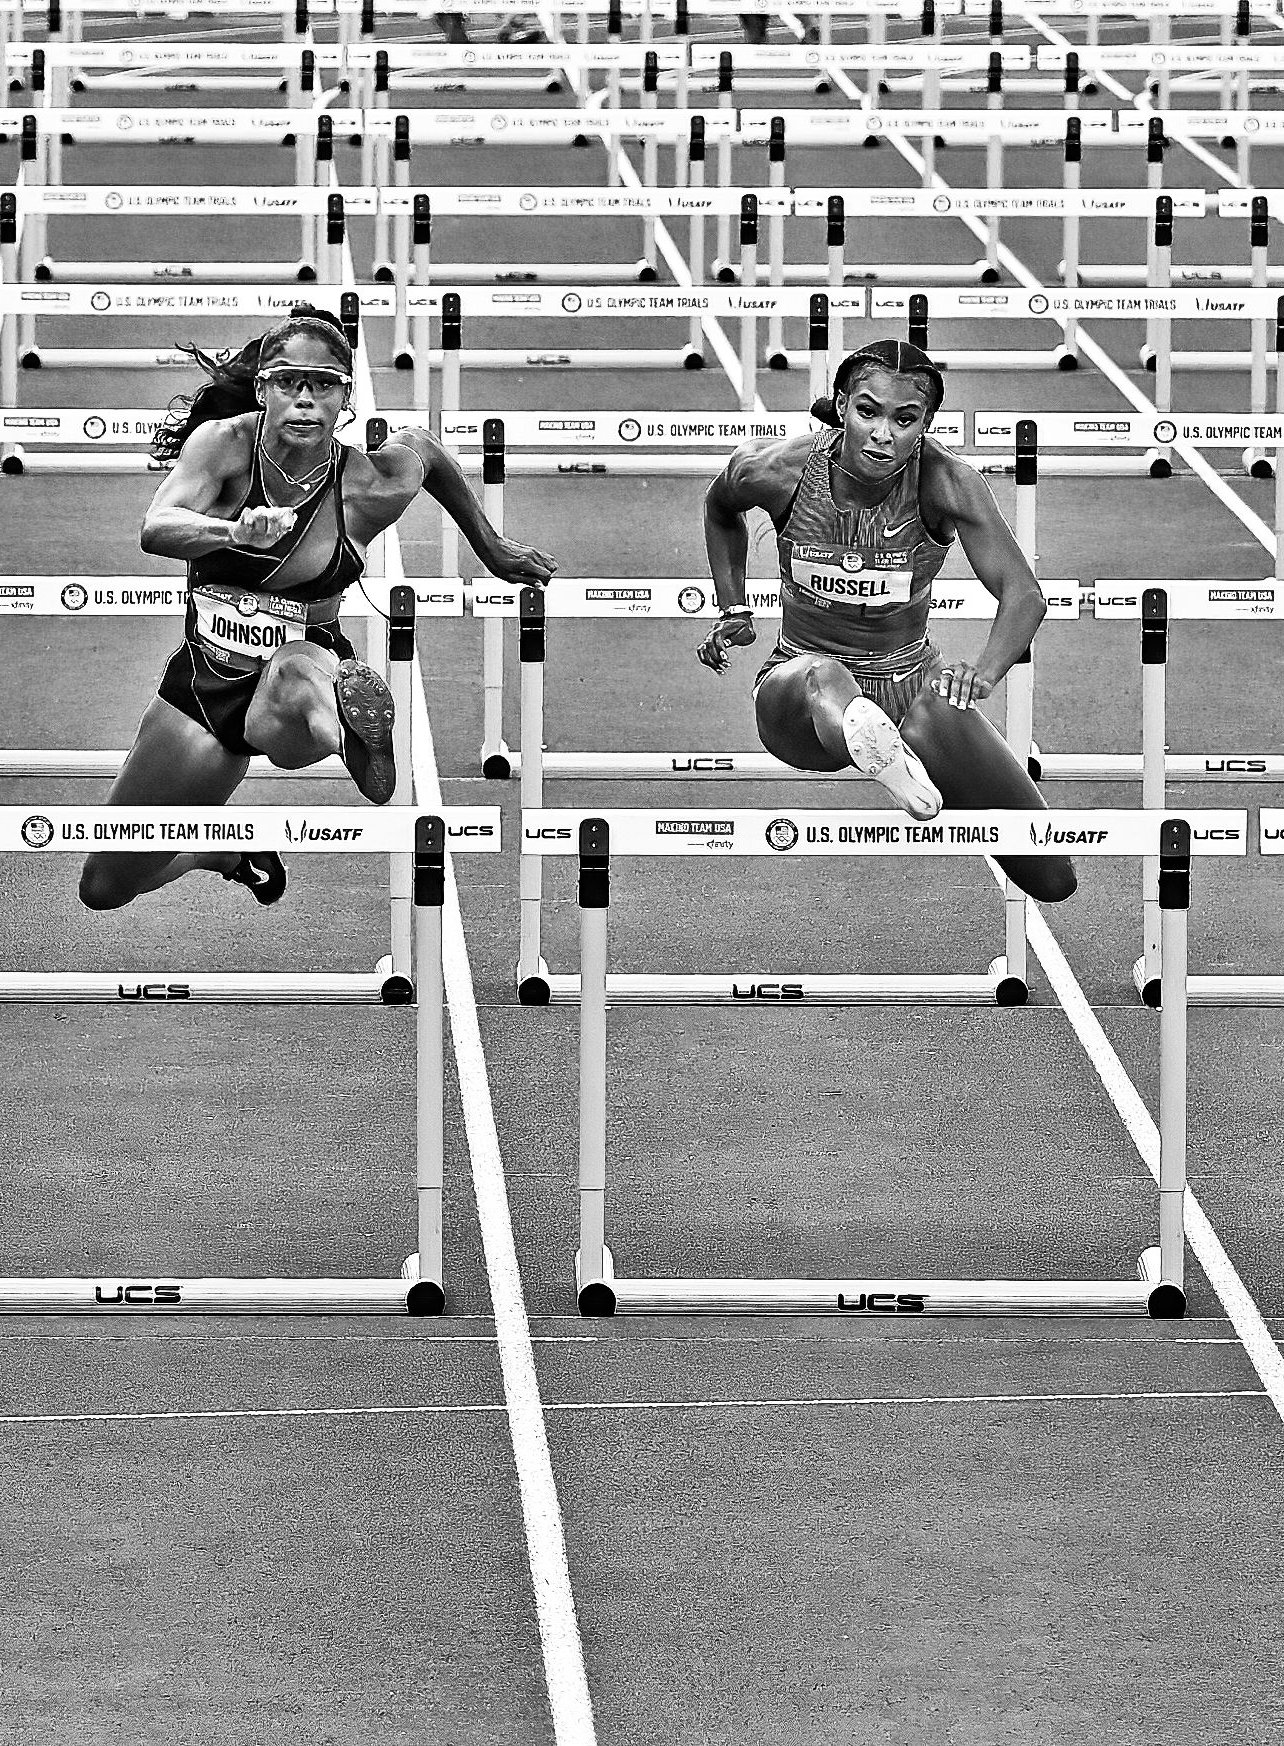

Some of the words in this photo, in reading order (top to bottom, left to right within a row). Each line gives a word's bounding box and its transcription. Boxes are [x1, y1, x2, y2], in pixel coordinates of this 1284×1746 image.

[608, 298, 645, 308] OLYMPIC
[649, 298, 673, 308] TEAM
[678, 298, 708, 308] TRIALS
[1075, 300, 1113, 309] OLYMPIC
[1117, 299, 1141, 309] TEAM
[1145, 299, 1176, 310] TRIALS
[113, 422, 128, 433] U.S.
[648, 424, 663, 436] U.S.
[671, 425, 714, 436] OLYMPIC
[719, 425, 745, 436] TEAM
[750, 425, 785, 436] TRIALS
[1183, 427, 1202, 438] U.S.
[1206, 427, 1250, 438] OLYMPIC
[1254, 427, 1281, 438] TEAM
[15, 587, 31, 597] USA
[810, 574, 891, 598] RUSSELL
[95, 591, 117, 604] U.S.
[122, 591, 172, 604] OLYMPIC
[476, 596, 515, 604] UCS
[632, 590, 648, 600] USA
[1099, 597, 1137, 605] UCS
[929, 598, 964, 609] SATF
[1044, 597, 1072, 608] CS
[210, 613, 287, 649] JOHNSON
[672, 758, 733, 770] UCS
[1205, 760, 1266, 772] UCS
[63, 824, 88, 839] U.S.
[94, 824, 154, 839] OLYMPIC
[160, 824, 198, 839] TEAM
[204, 824, 253, 840] TRIALS
[309, 828, 363, 840] USATF
[448, 826, 493, 836] UCS
[526, 829, 572, 839] UCS
[690, 822, 713, 833] TEAM
[714, 823, 732, 834] USA
[807, 827, 833, 843] U.S.
[839, 827, 899, 843] OLYMPIC
[905, 826, 943, 844] TEAM
[948, 827, 998, 843] TRIALS
[1054, 831, 1108, 843] USATF
[1194, 830, 1240, 840] UCS
[117, 983, 191, 1000] UCS
[730, 984, 808, 1000] UCS
[93, 1286, 185, 1304] UCS
[835, 1294, 930, 1310] UCS
